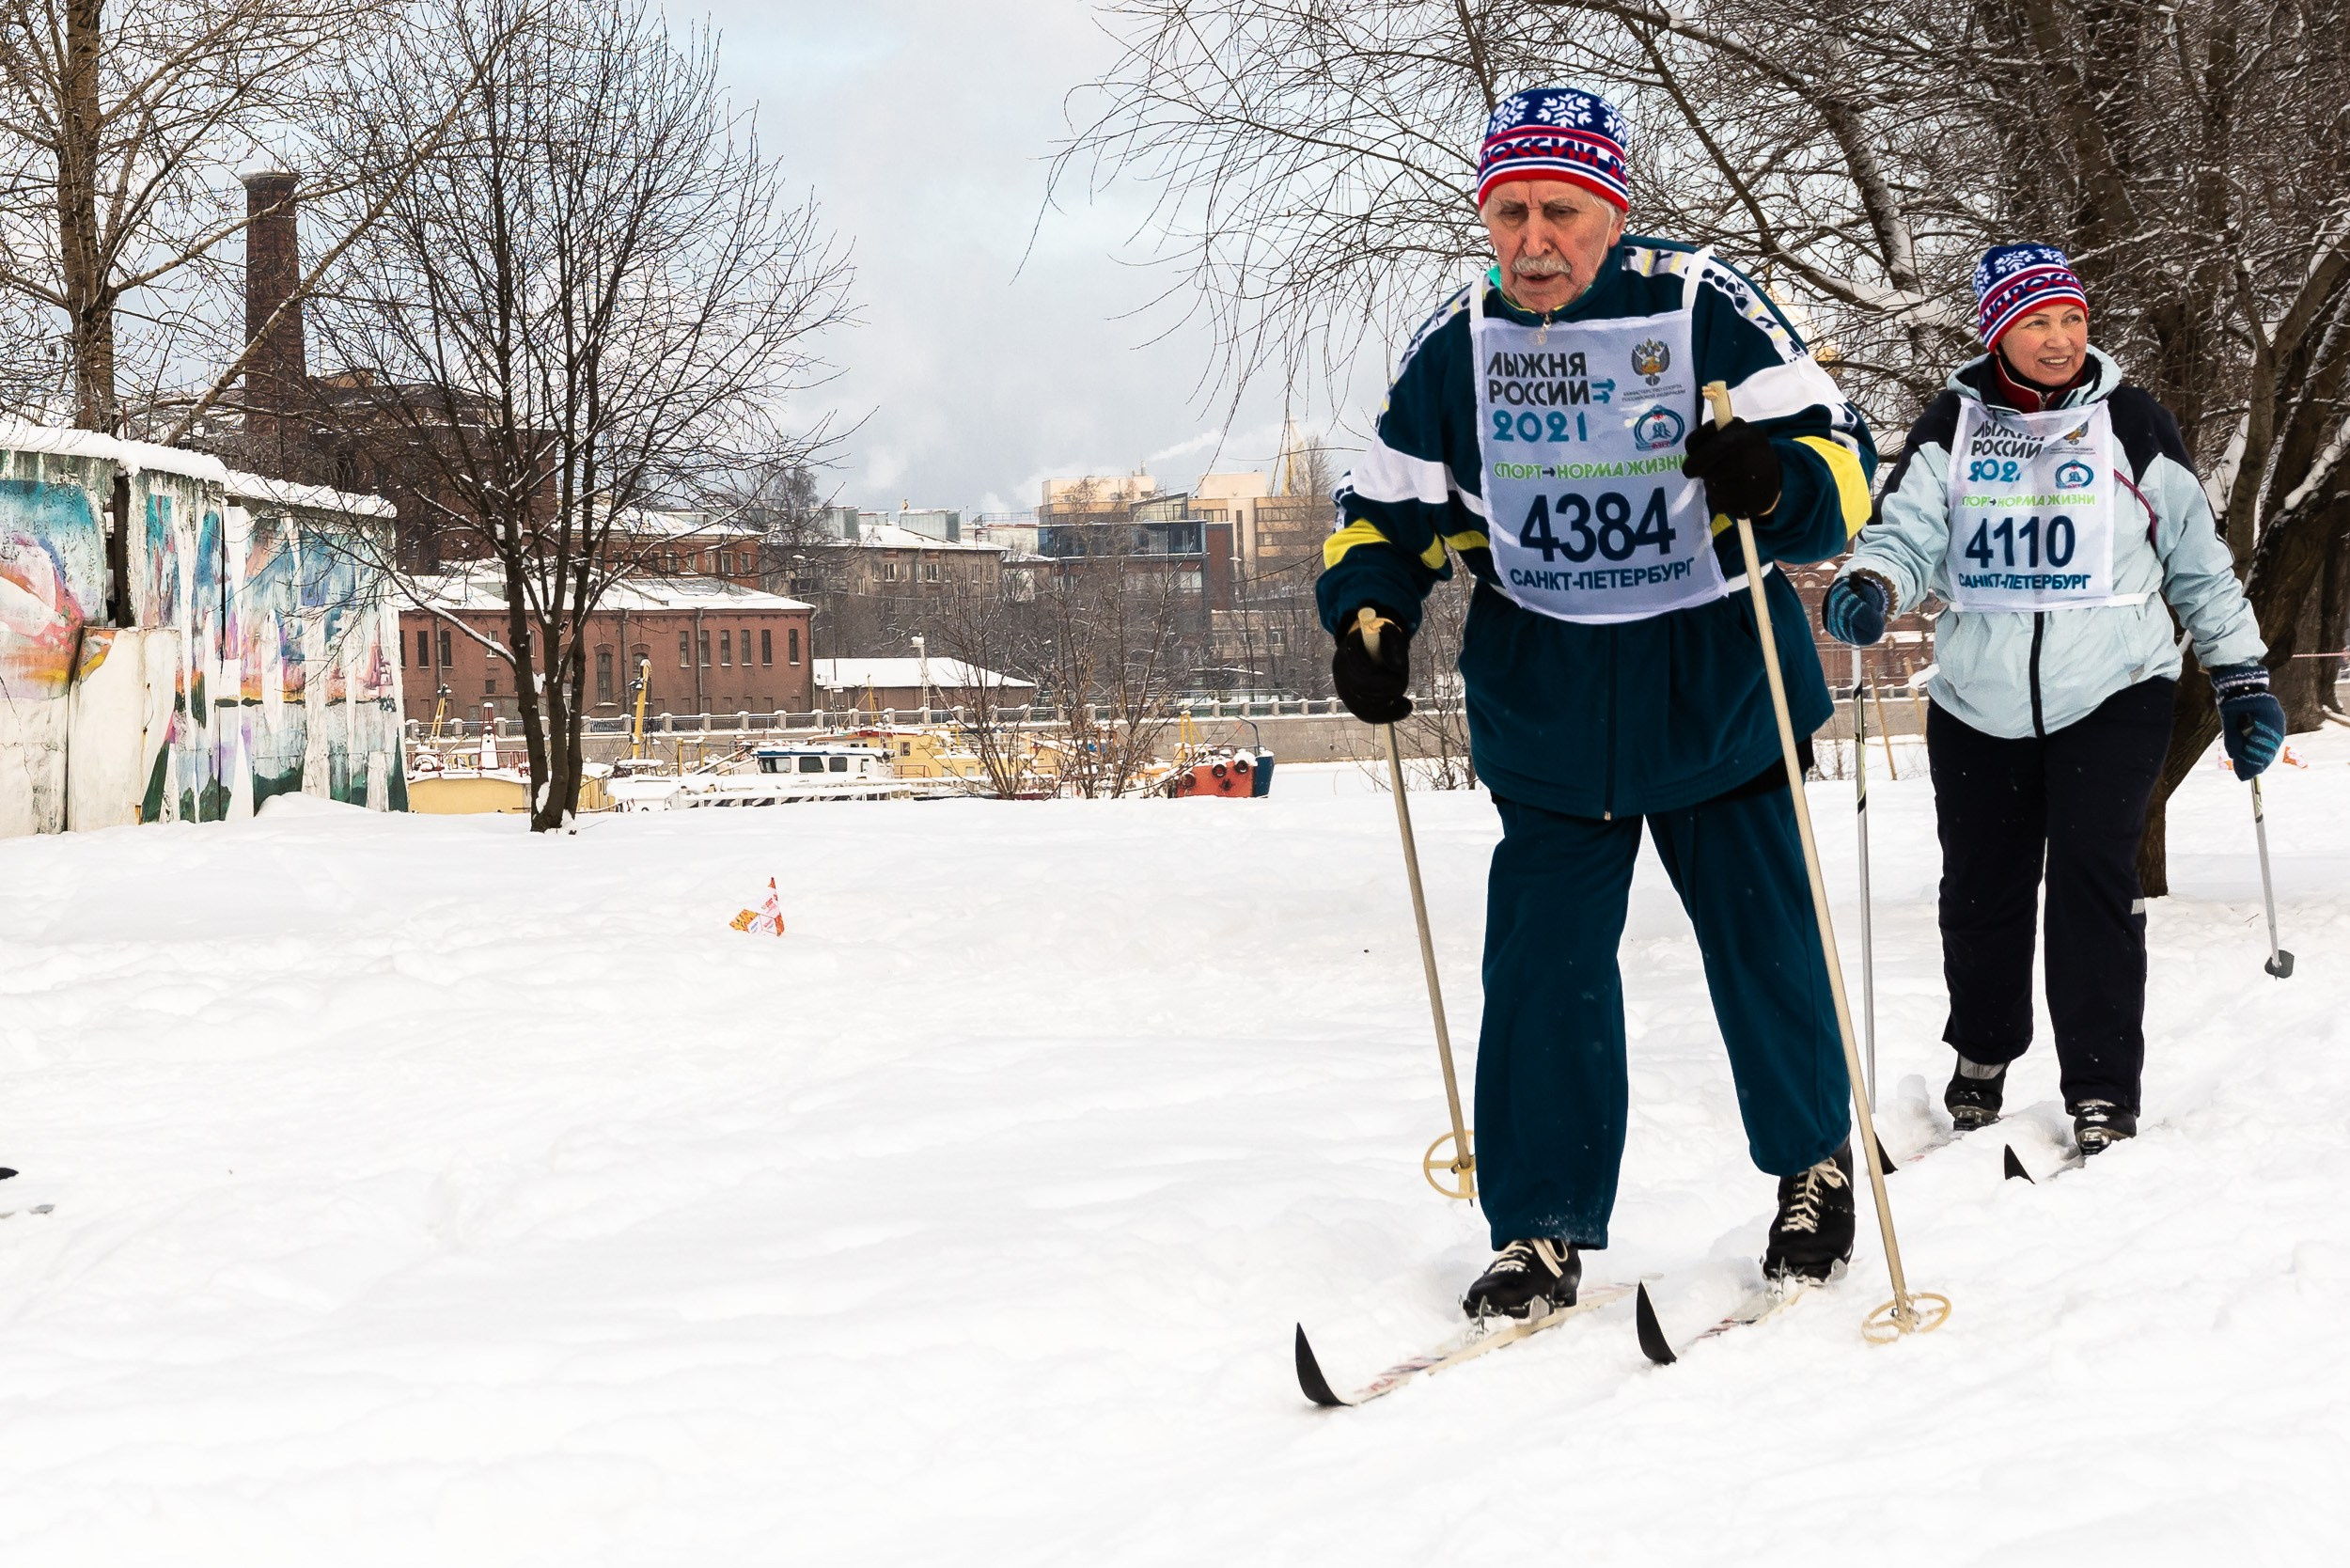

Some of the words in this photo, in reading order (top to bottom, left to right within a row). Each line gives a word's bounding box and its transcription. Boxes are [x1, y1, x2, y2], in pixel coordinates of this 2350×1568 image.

[1486, 352, 1588, 378] ЛЫЖНЯ
[1488, 379, 1590, 406] РОССИИ
[1493, 410, 1588, 443] 2021
[1971, 439, 2043, 459] РОССИИ
[1493, 462, 1543, 479] СПОРТ
[1556, 461, 1624, 480] НОРМА
[1998, 495, 2044, 508] НОРМА
[2047, 494, 2096, 506] ЖИЗНИ
[1519, 487, 1676, 563] 4384
[1965, 515, 2076, 568] 4110
[1510, 557, 1695, 590] САНКТ-ПЕТЕРБУРГ
[1958, 572, 2091, 590] САНКТ-ПЕТЕРБУРГ
